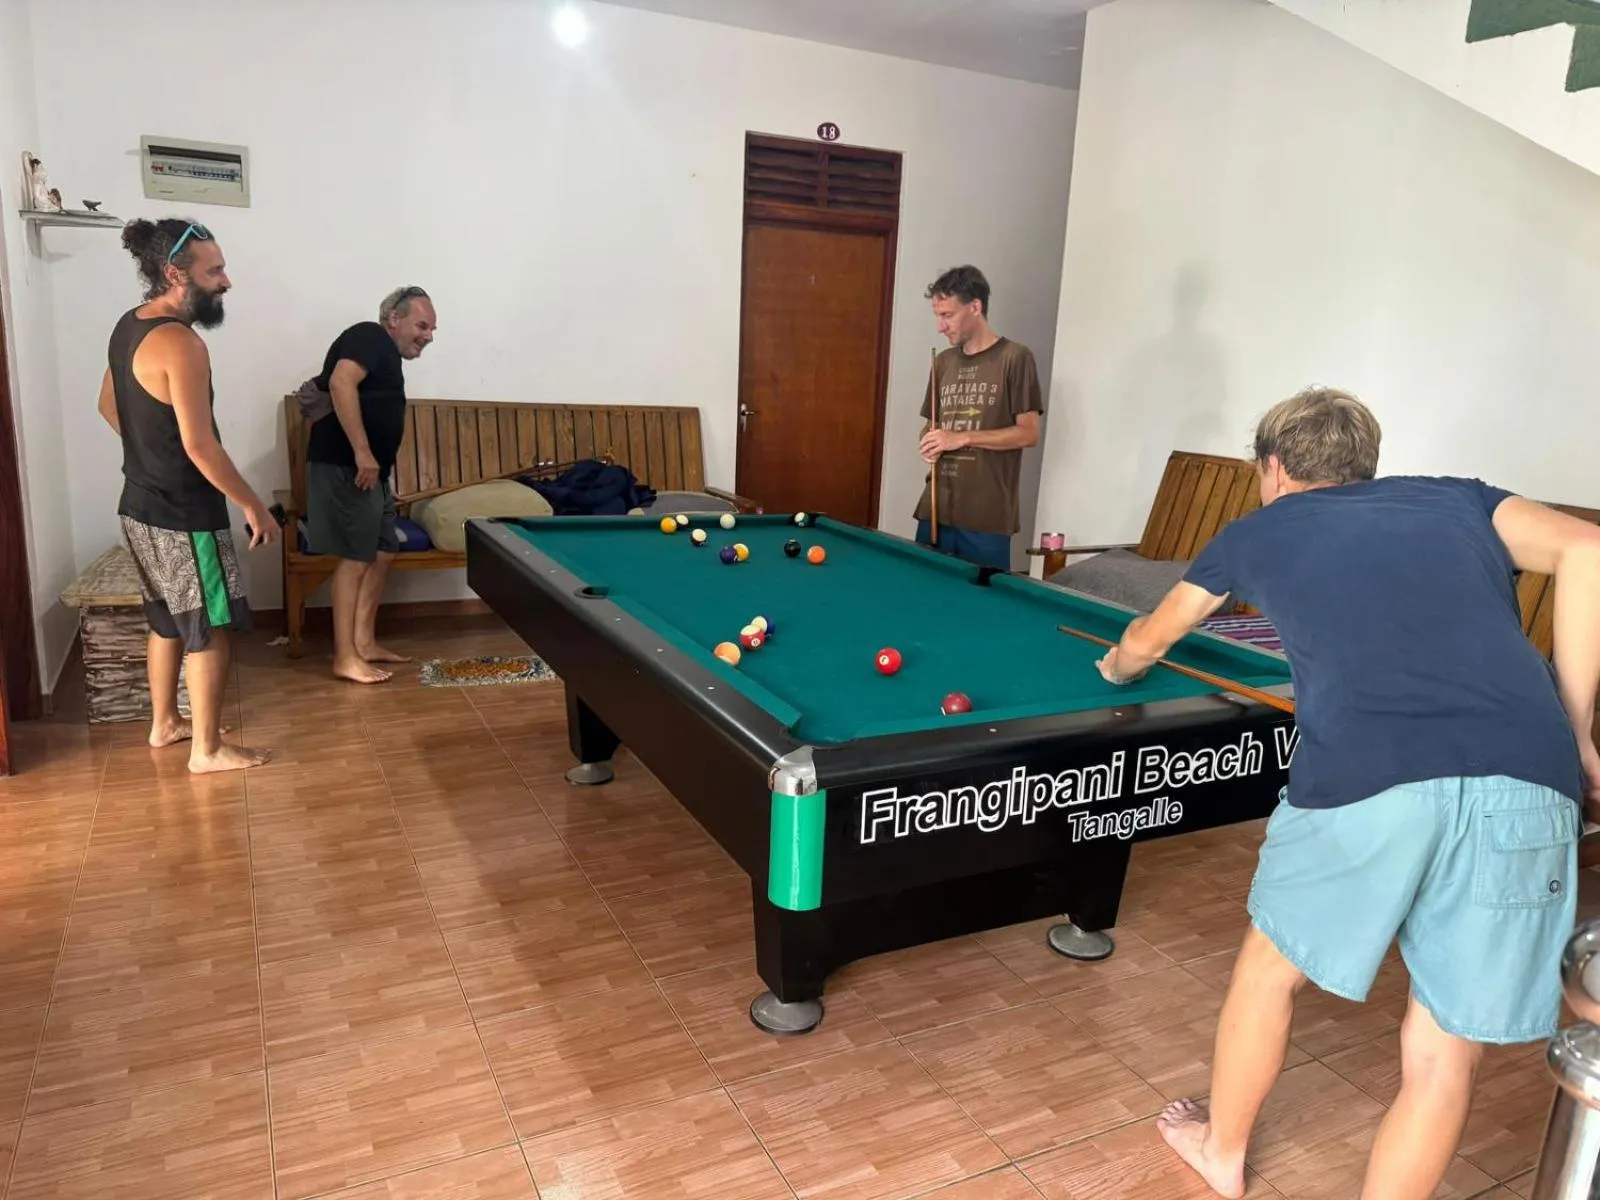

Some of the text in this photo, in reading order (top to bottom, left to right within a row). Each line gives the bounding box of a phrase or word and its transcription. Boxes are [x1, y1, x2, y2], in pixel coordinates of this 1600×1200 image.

[822, 126, 835, 139] 18
[860, 751, 1126, 844] Frangipani
[1134, 732, 1264, 794] Beach
[1068, 796, 1183, 843] Tangalle
